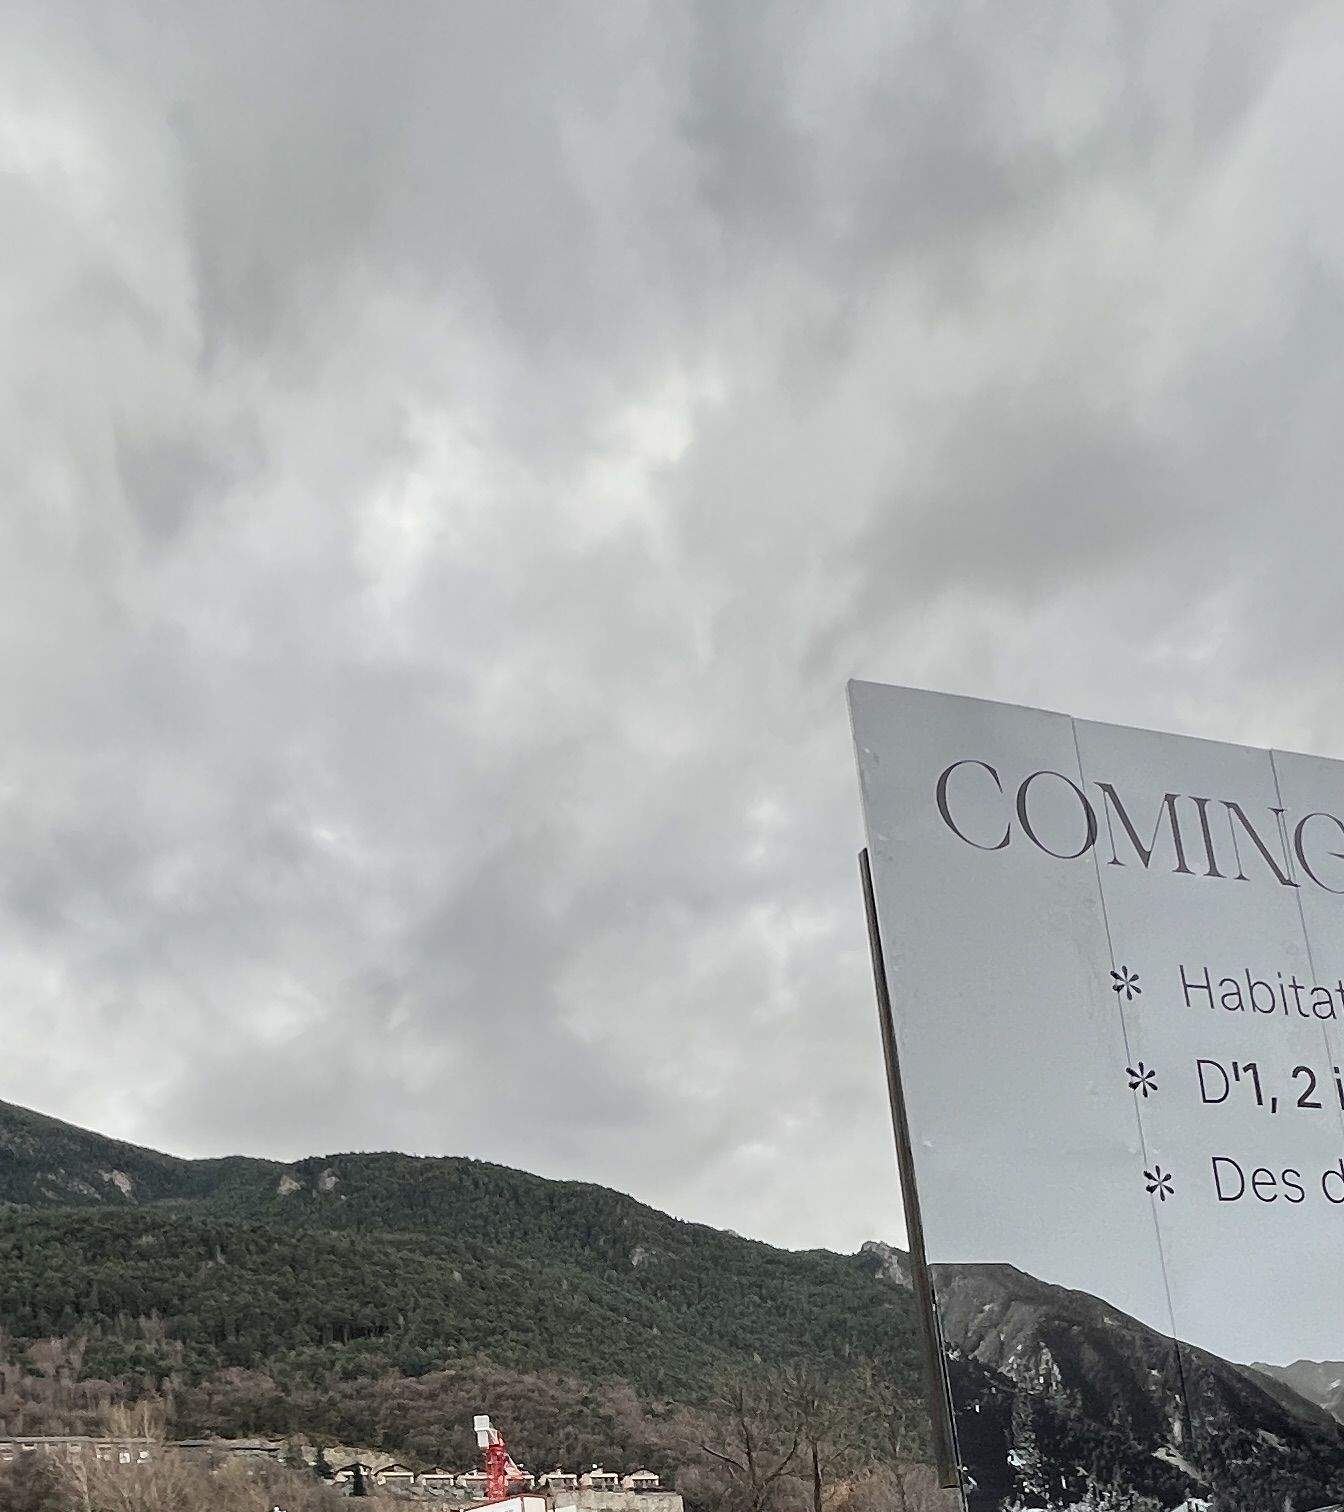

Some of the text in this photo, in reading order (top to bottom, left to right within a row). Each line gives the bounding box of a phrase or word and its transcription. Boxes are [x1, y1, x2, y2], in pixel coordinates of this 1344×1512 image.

[1196, 1058, 1278, 1114] D'1,
[1291, 1065, 1323, 1109] 2
[1211, 1156, 1306, 1204] Des
